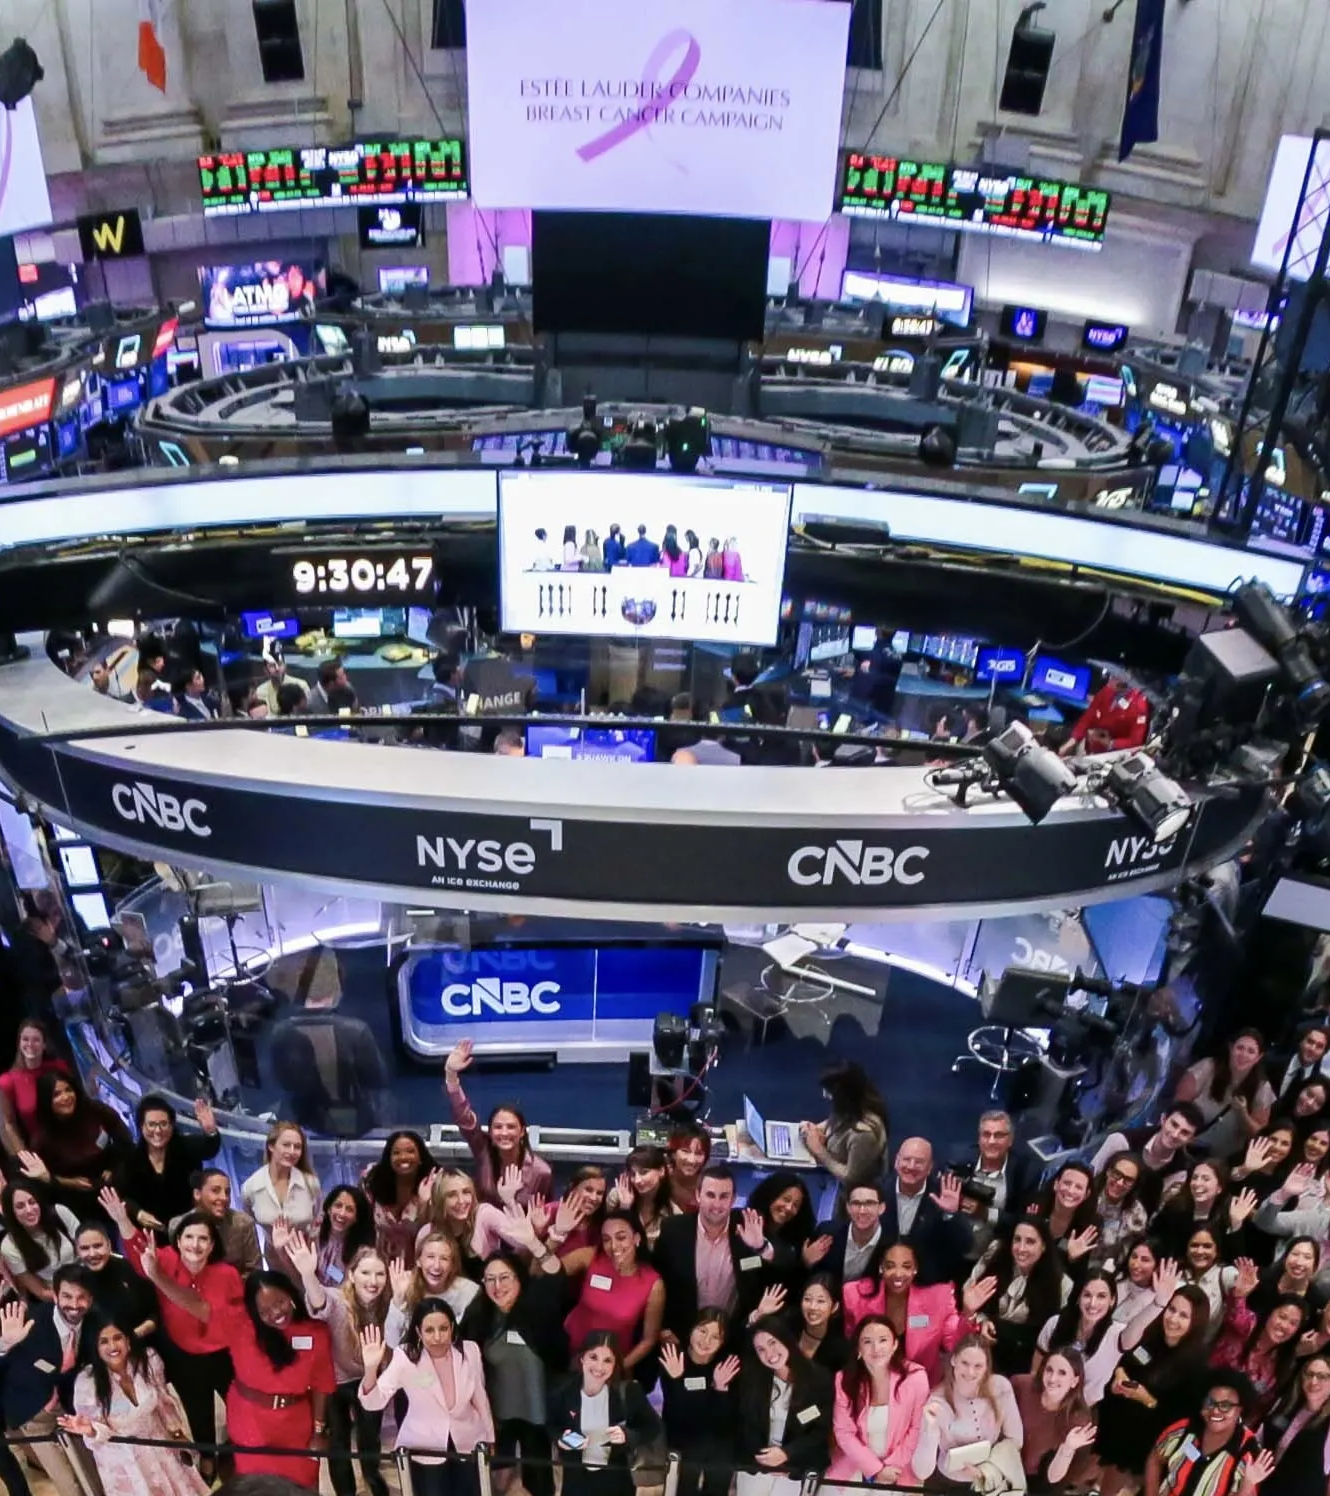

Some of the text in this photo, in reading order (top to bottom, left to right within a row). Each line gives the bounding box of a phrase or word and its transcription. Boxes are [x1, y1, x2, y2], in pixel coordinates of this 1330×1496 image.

[581, 79, 664, 99] LAUDER
[669, 82, 791, 109] COMPANIES
[526, 105, 784, 132] BREAST CANCER CAMPAIGN
[94, 214, 125, 255] W
[292, 556, 434, 594] 9:30:47
[110, 782, 212, 838] CNBC
[787, 839, 930, 886] CNBC
[440, 977, 562, 1017] CNBC
